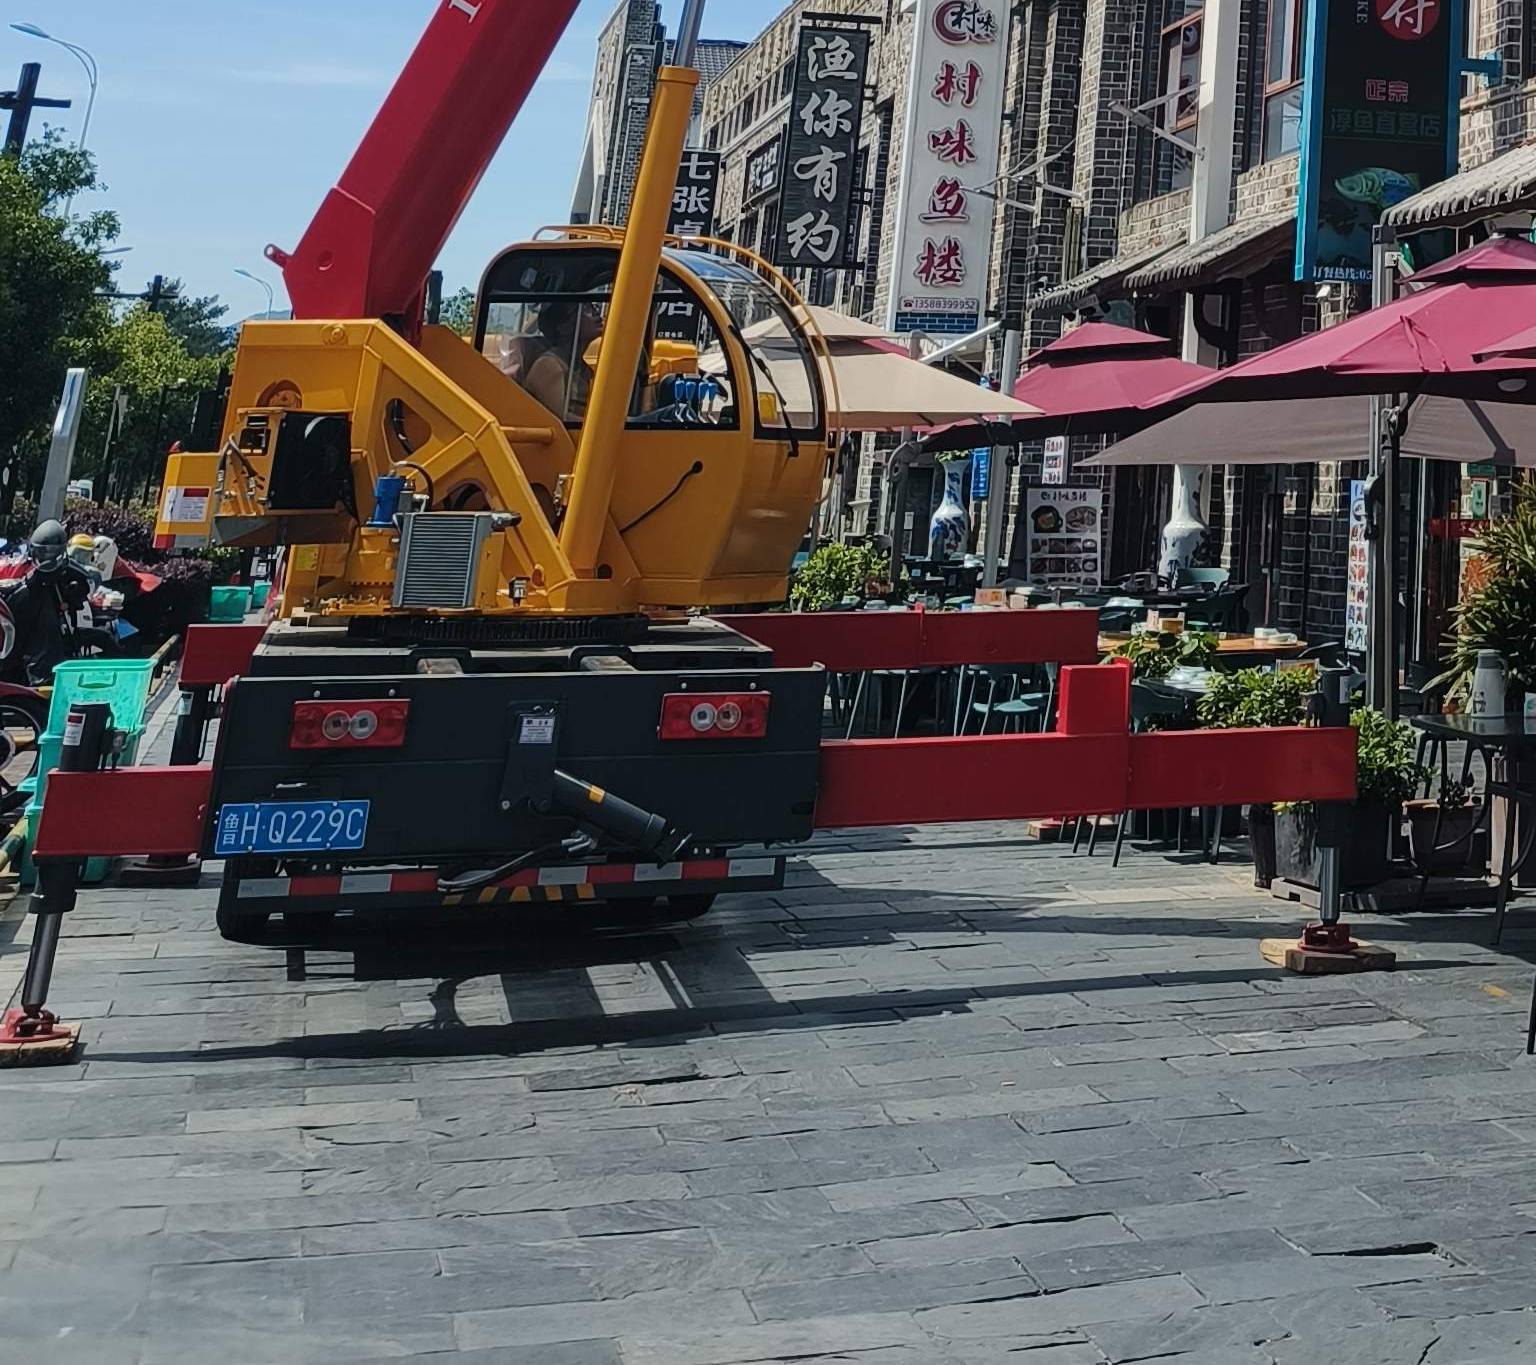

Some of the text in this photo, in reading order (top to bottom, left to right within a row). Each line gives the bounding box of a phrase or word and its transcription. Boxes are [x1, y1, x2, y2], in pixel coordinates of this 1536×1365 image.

[787, 35, 858, 263] 渔你有约
[918, 61, 984, 287] 村味鱼楼
[914, 298, 976, 311] 13588399952
